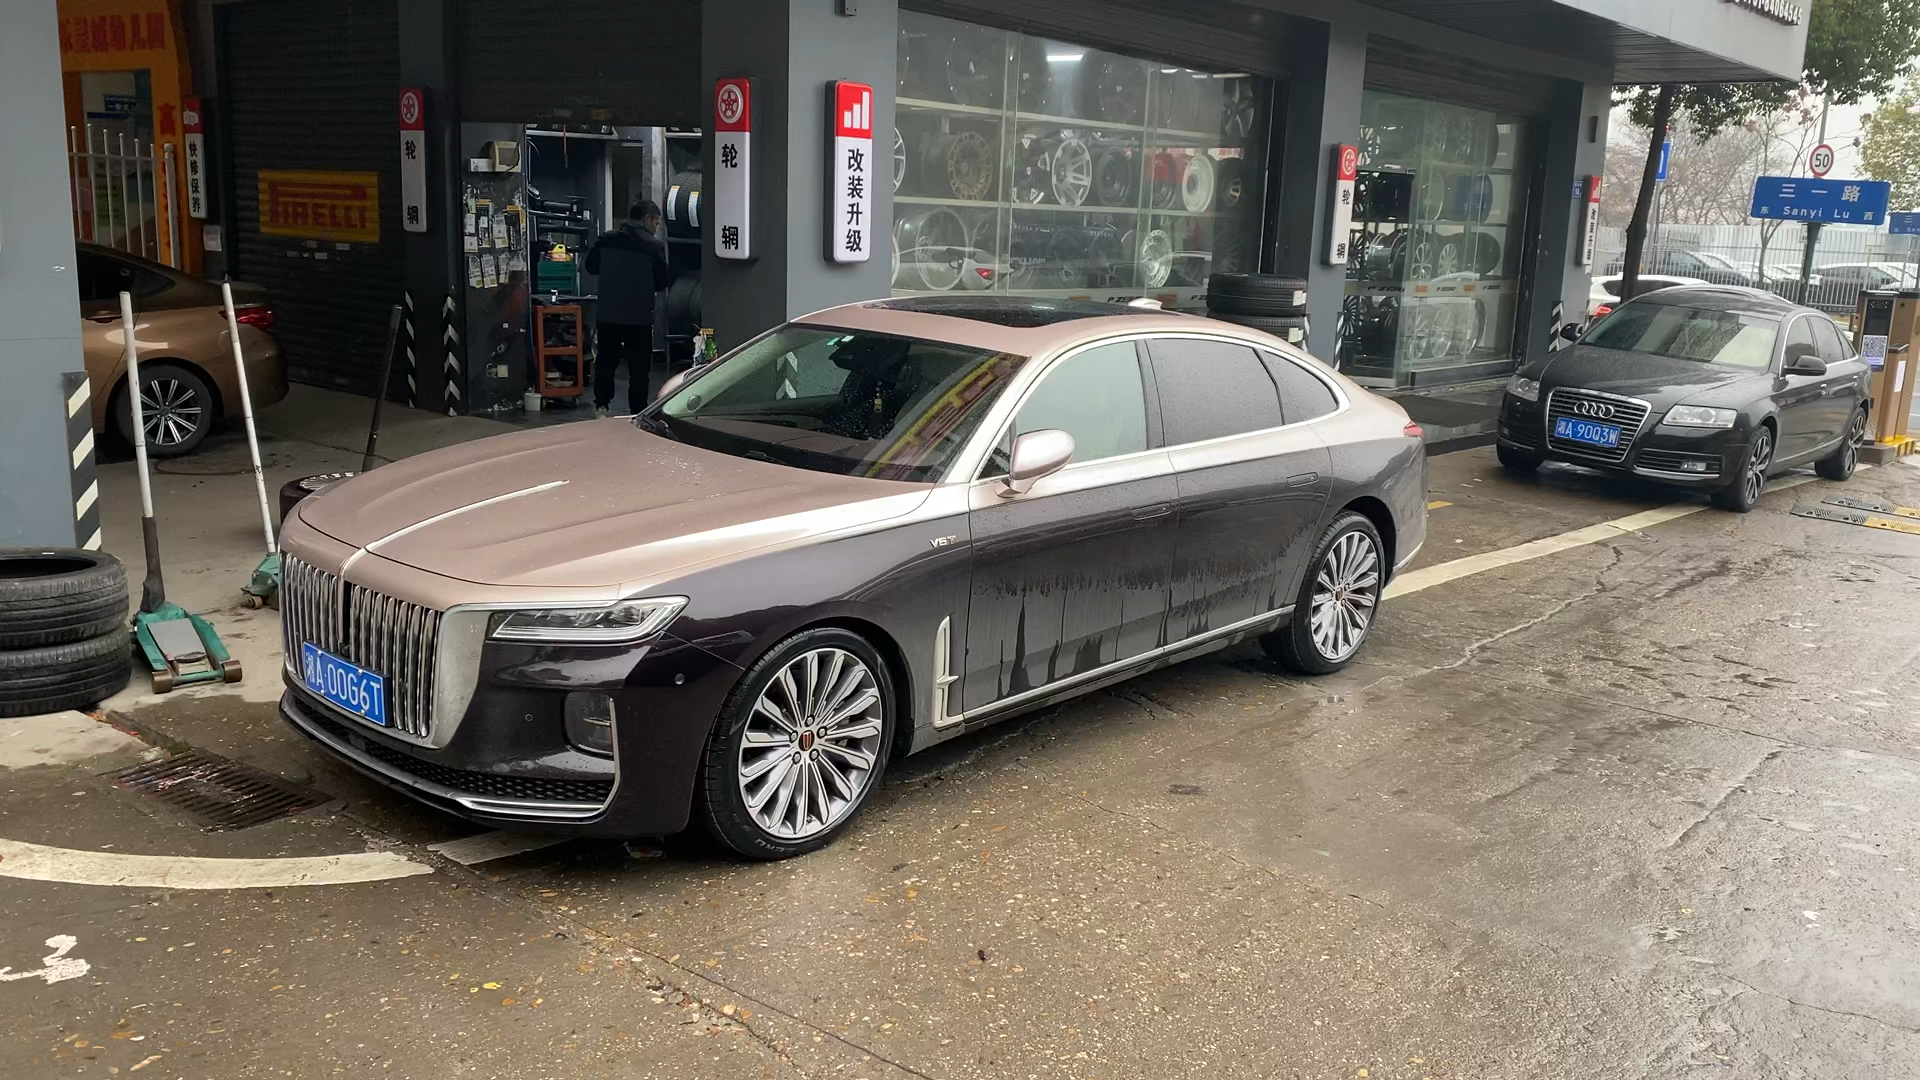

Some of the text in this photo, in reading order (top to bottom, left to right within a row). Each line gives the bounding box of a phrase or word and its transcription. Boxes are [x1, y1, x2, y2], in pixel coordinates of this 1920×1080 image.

[1815, 153, 1830, 168] 50
[721, 143, 739, 250] 轮辋
[845, 148, 864, 252] 改装升级
[1779, 183, 1860, 202] 三一路
[268, 182, 367, 229] PIRELLI
[1760, 206, 1769, 215] 东
[1783, 206, 1850, 219] Sanyi Lu
[1863, 211, 1874, 220] 西
[1115, 295, 1144, 303] ZER
